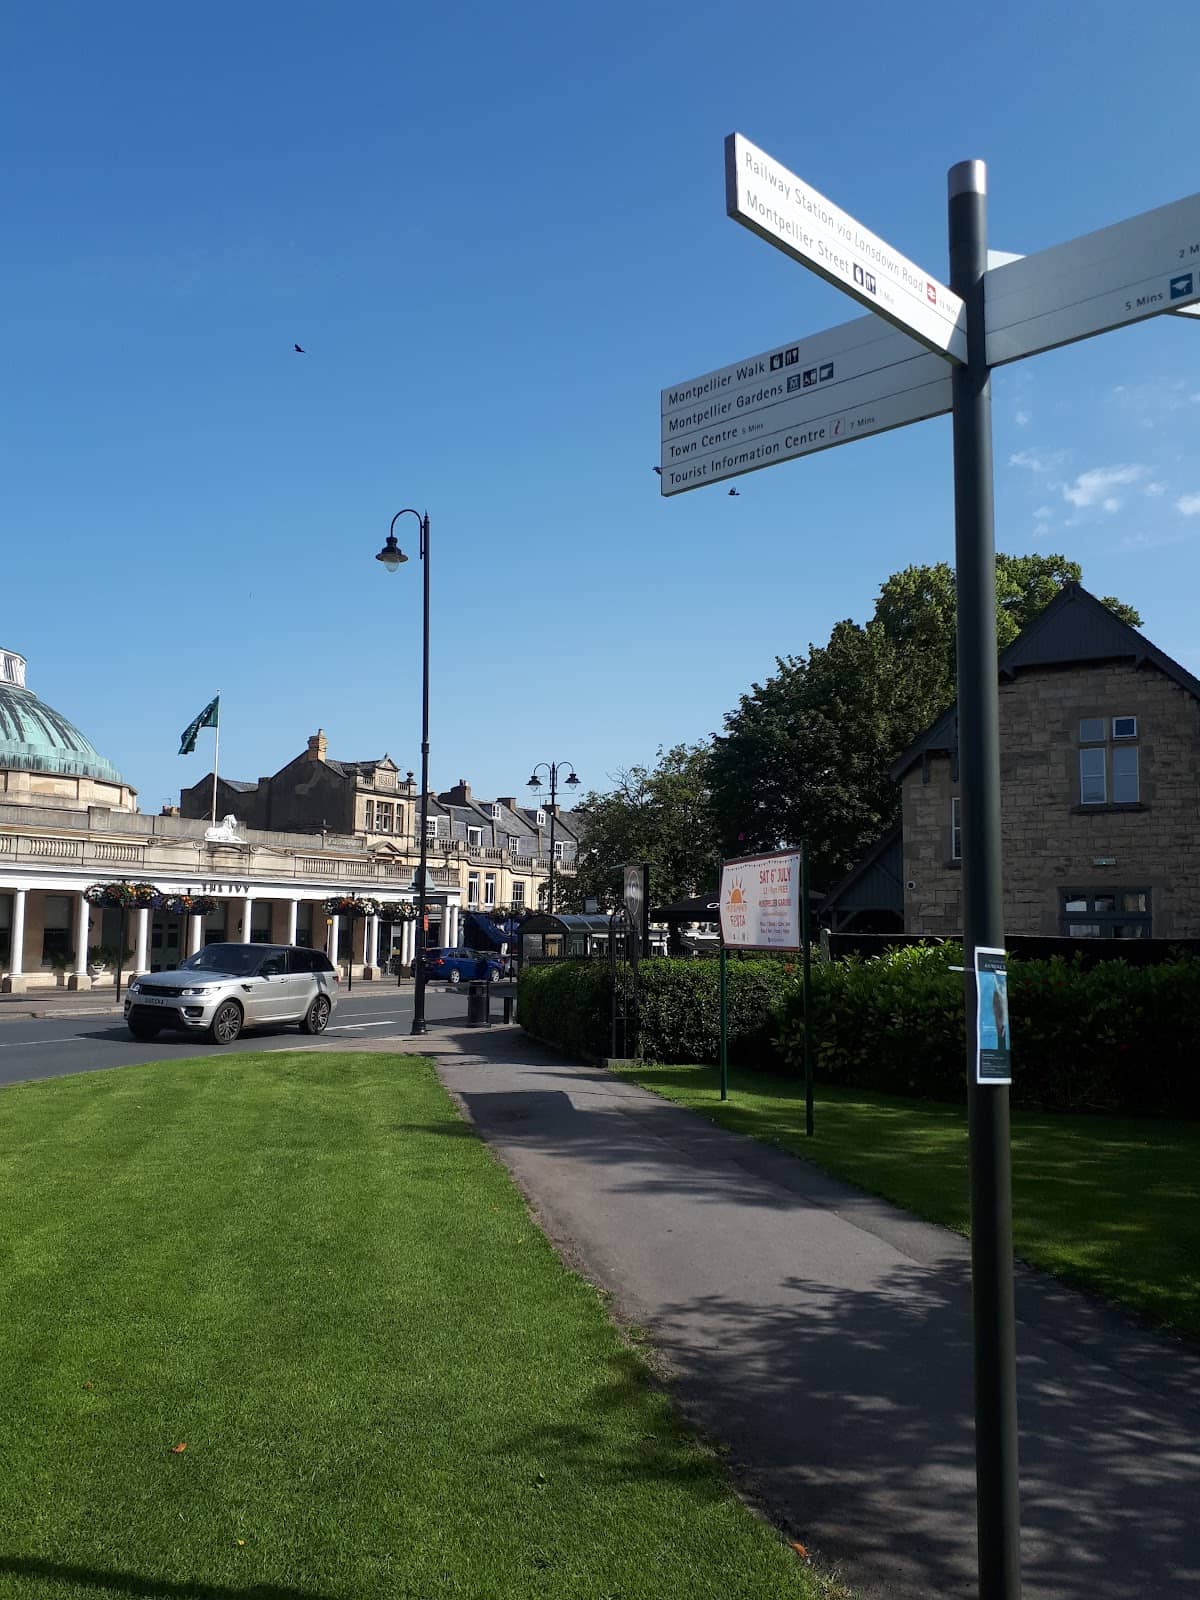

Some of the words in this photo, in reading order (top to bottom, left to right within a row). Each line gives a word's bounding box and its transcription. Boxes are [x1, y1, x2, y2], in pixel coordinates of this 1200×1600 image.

[745, 151, 790, 200] Railway
[795, 188, 834, 228] Station
[837, 223, 851, 241] via
[902, 266, 923, 293] Road
[746, 189, 814, 249] Montpellier
[818, 240, 849, 274] Street
[1179, 249, 1185, 258] 2
[1125, 300, 1132, 312] 5
[1136, 292, 1163, 307] Mins
[668, 375, 732, 406] Montpellier
[736, 361, 765, 381] Walk
[668, 402, 732, 432] Montpellier
[736, 384, 783, 408] Gardens
[670, 441, 697, 458] Town
[701, 427, 738, 448] Centre
[748, 423, 764, 433] Mins
[670, 465, 707, 484] Tourist
[711, 442, 780, 472] Information
[785, 428, 825, 448] Centre
[857, 416, 875, 426] Mins
[760, 869, 770, 884] SAT
[777, 866, 791, 882] JULY
